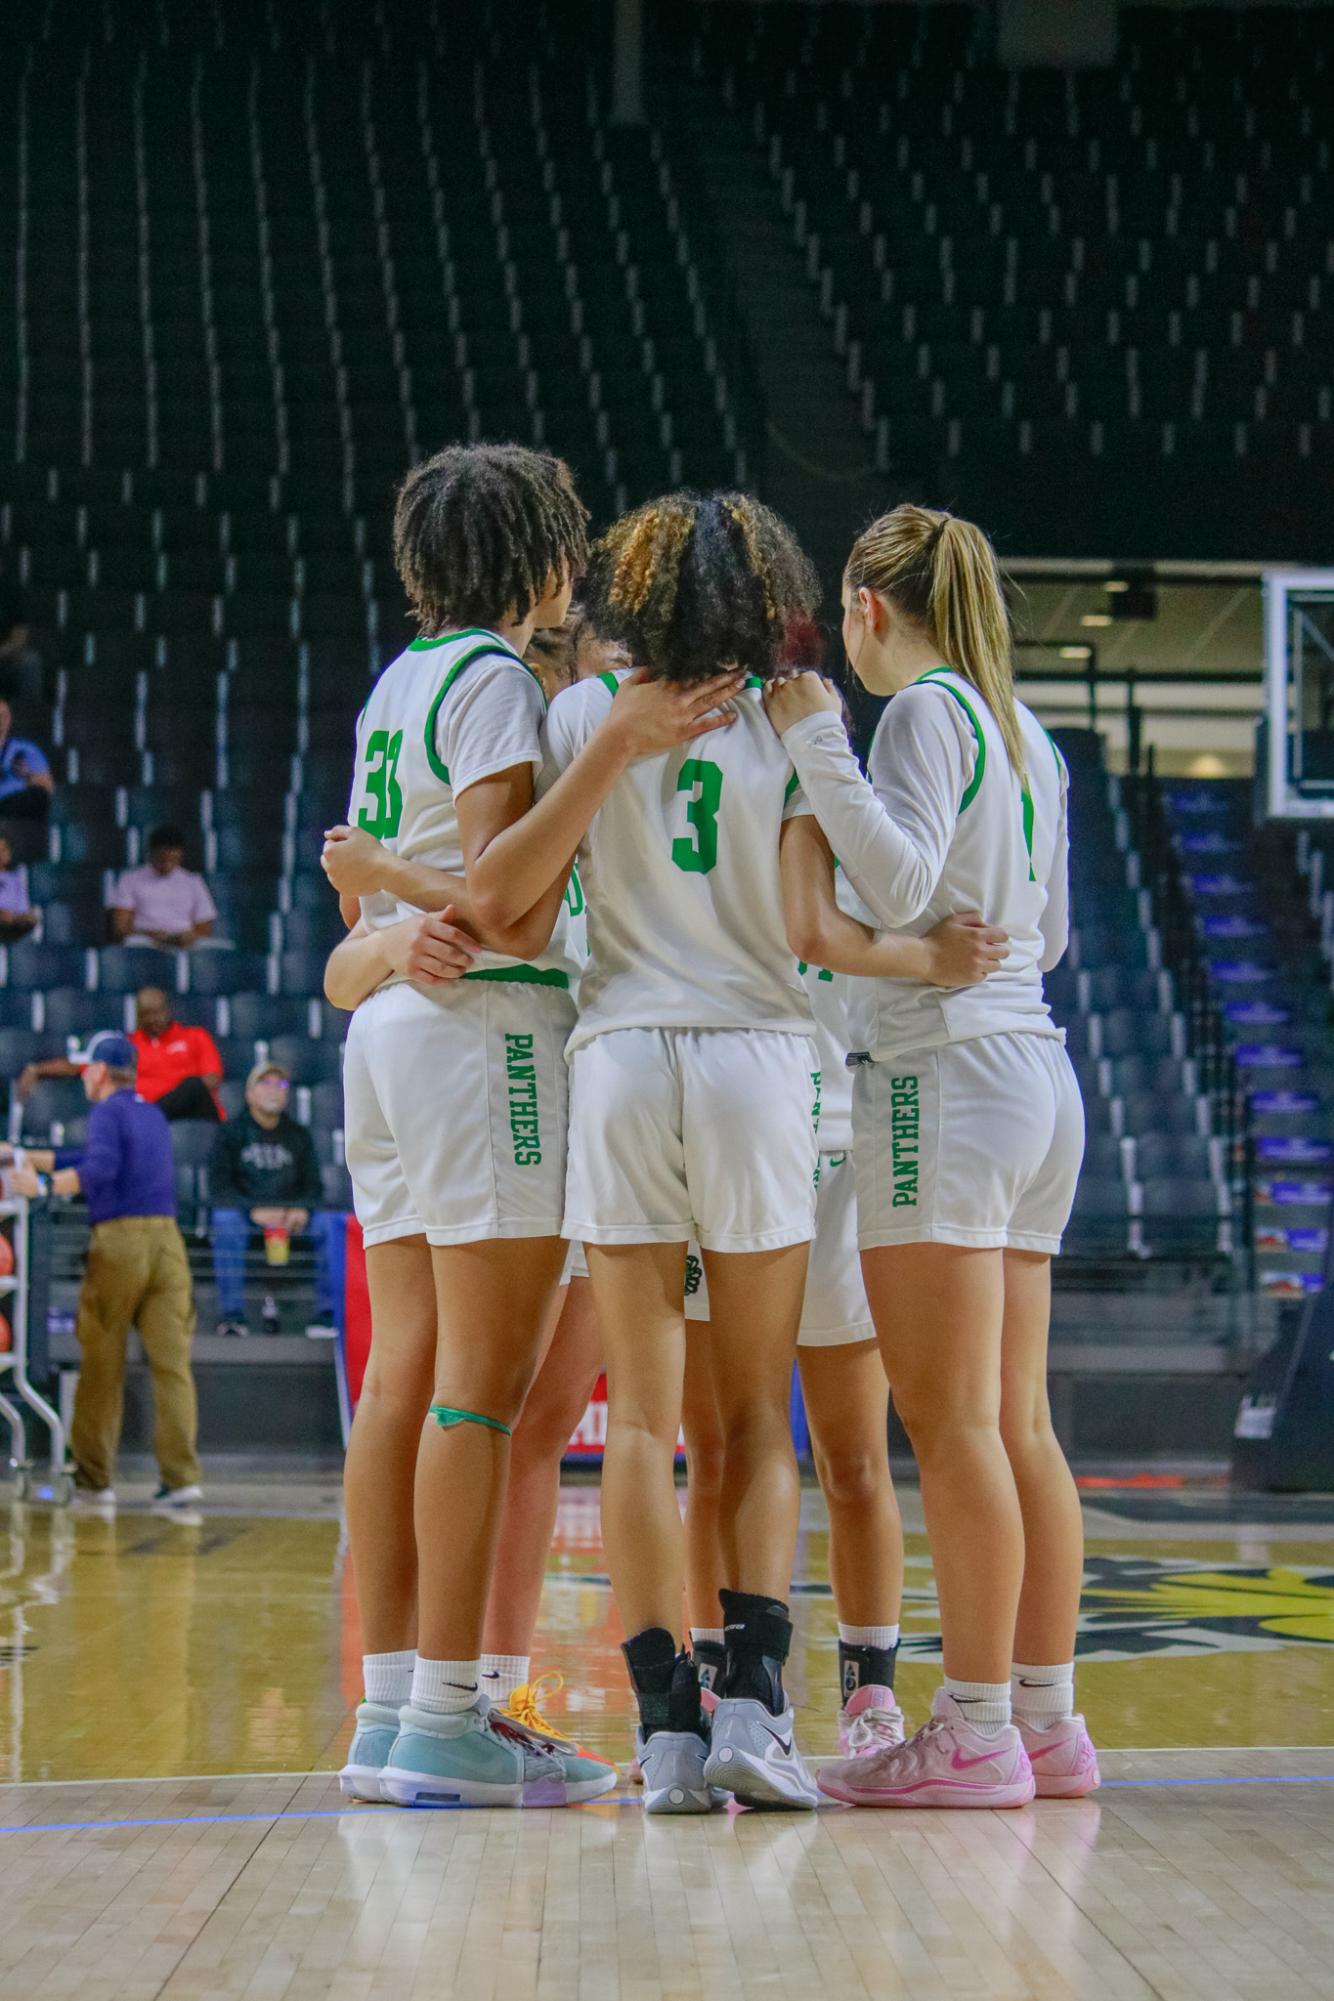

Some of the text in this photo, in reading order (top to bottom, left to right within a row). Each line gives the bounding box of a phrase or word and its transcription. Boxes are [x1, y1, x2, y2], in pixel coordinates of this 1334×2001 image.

[671, 758, 724, 875] 3
[505, 1032, 542, 1167] PANTHERS
[890, 1075, 920, 1208] PANTHERS
